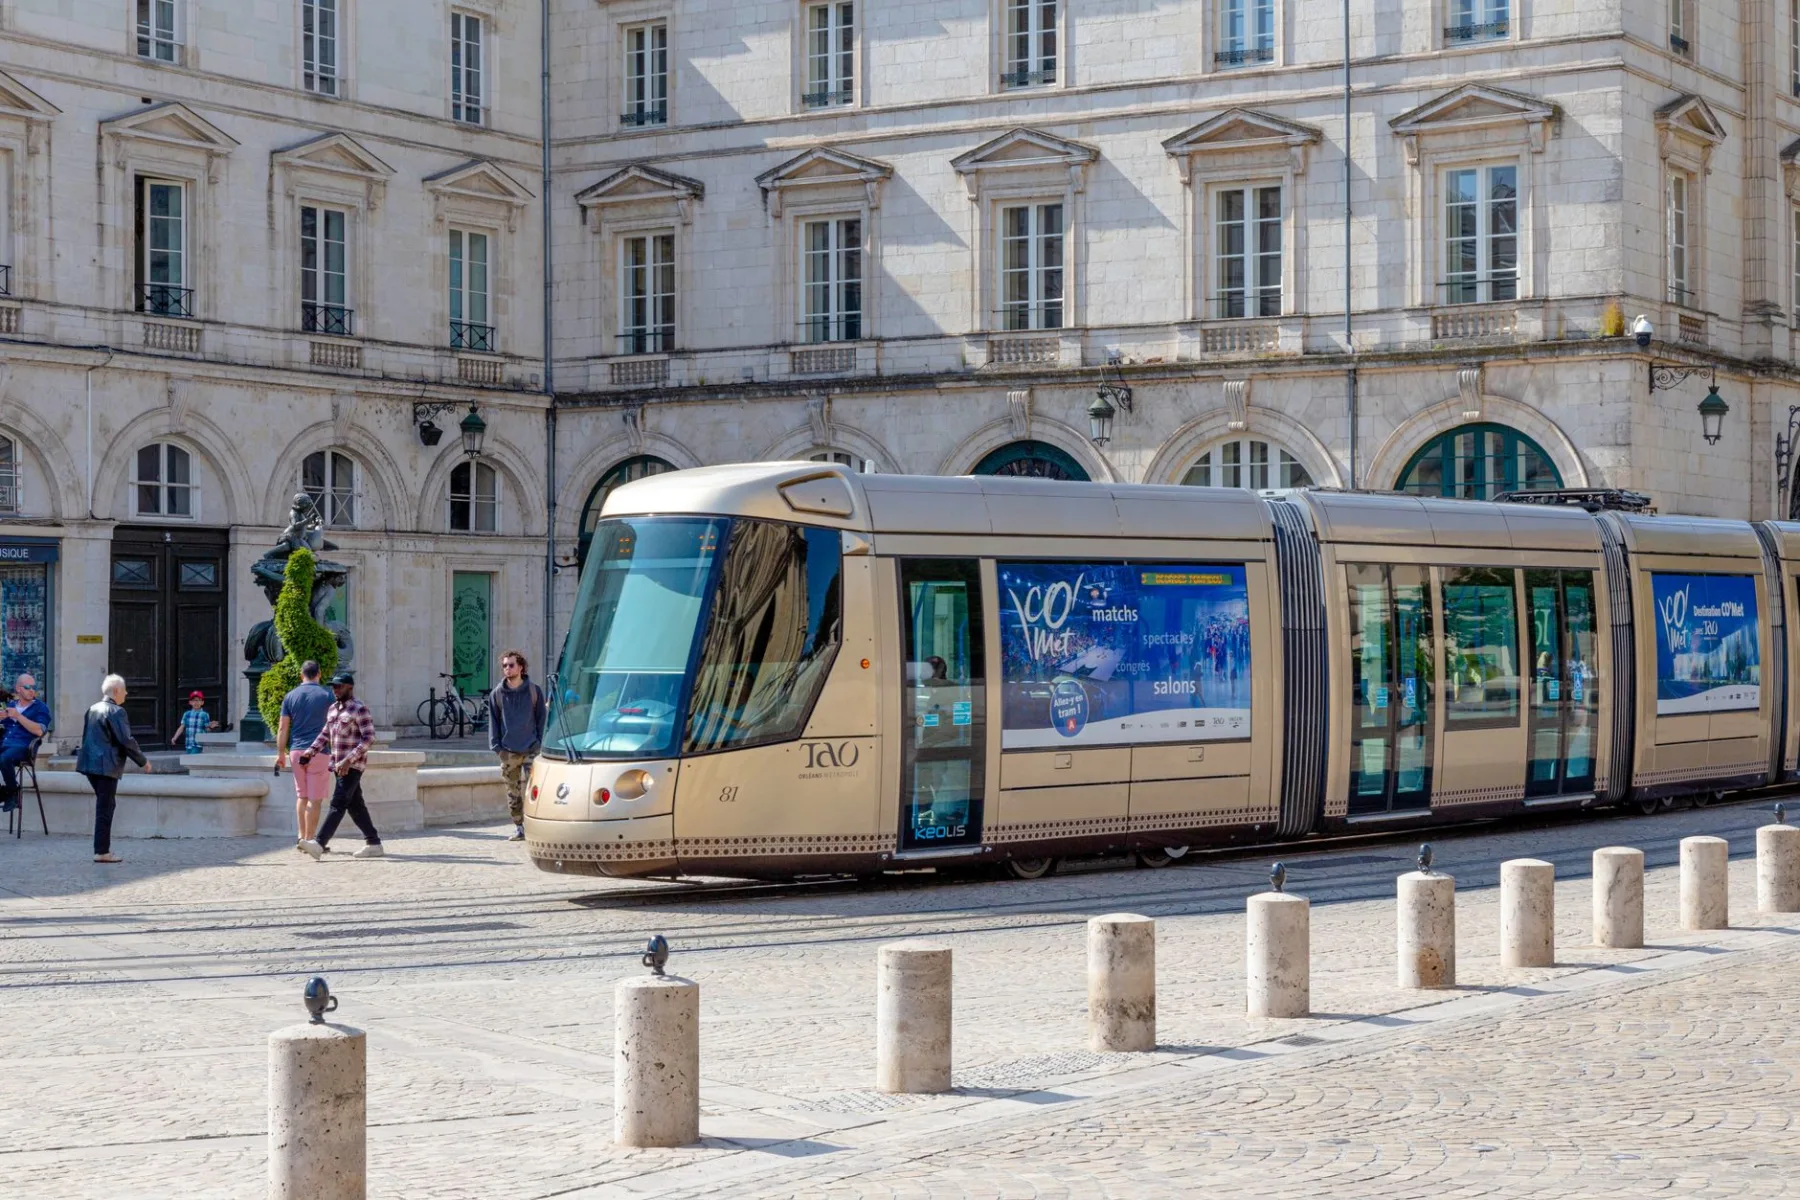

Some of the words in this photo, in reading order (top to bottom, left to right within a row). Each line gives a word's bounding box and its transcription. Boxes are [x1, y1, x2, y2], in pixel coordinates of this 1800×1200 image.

[1092, 604, 1139, 622] matchs
[1143, 631, 1194, 649] spectacles
[1116, 660, 1151, 676] congrès
[1153, 675, 1197, 695] salons
[1058, 707, 1077, 718] tram
[719, 785, 739, 803] 81
